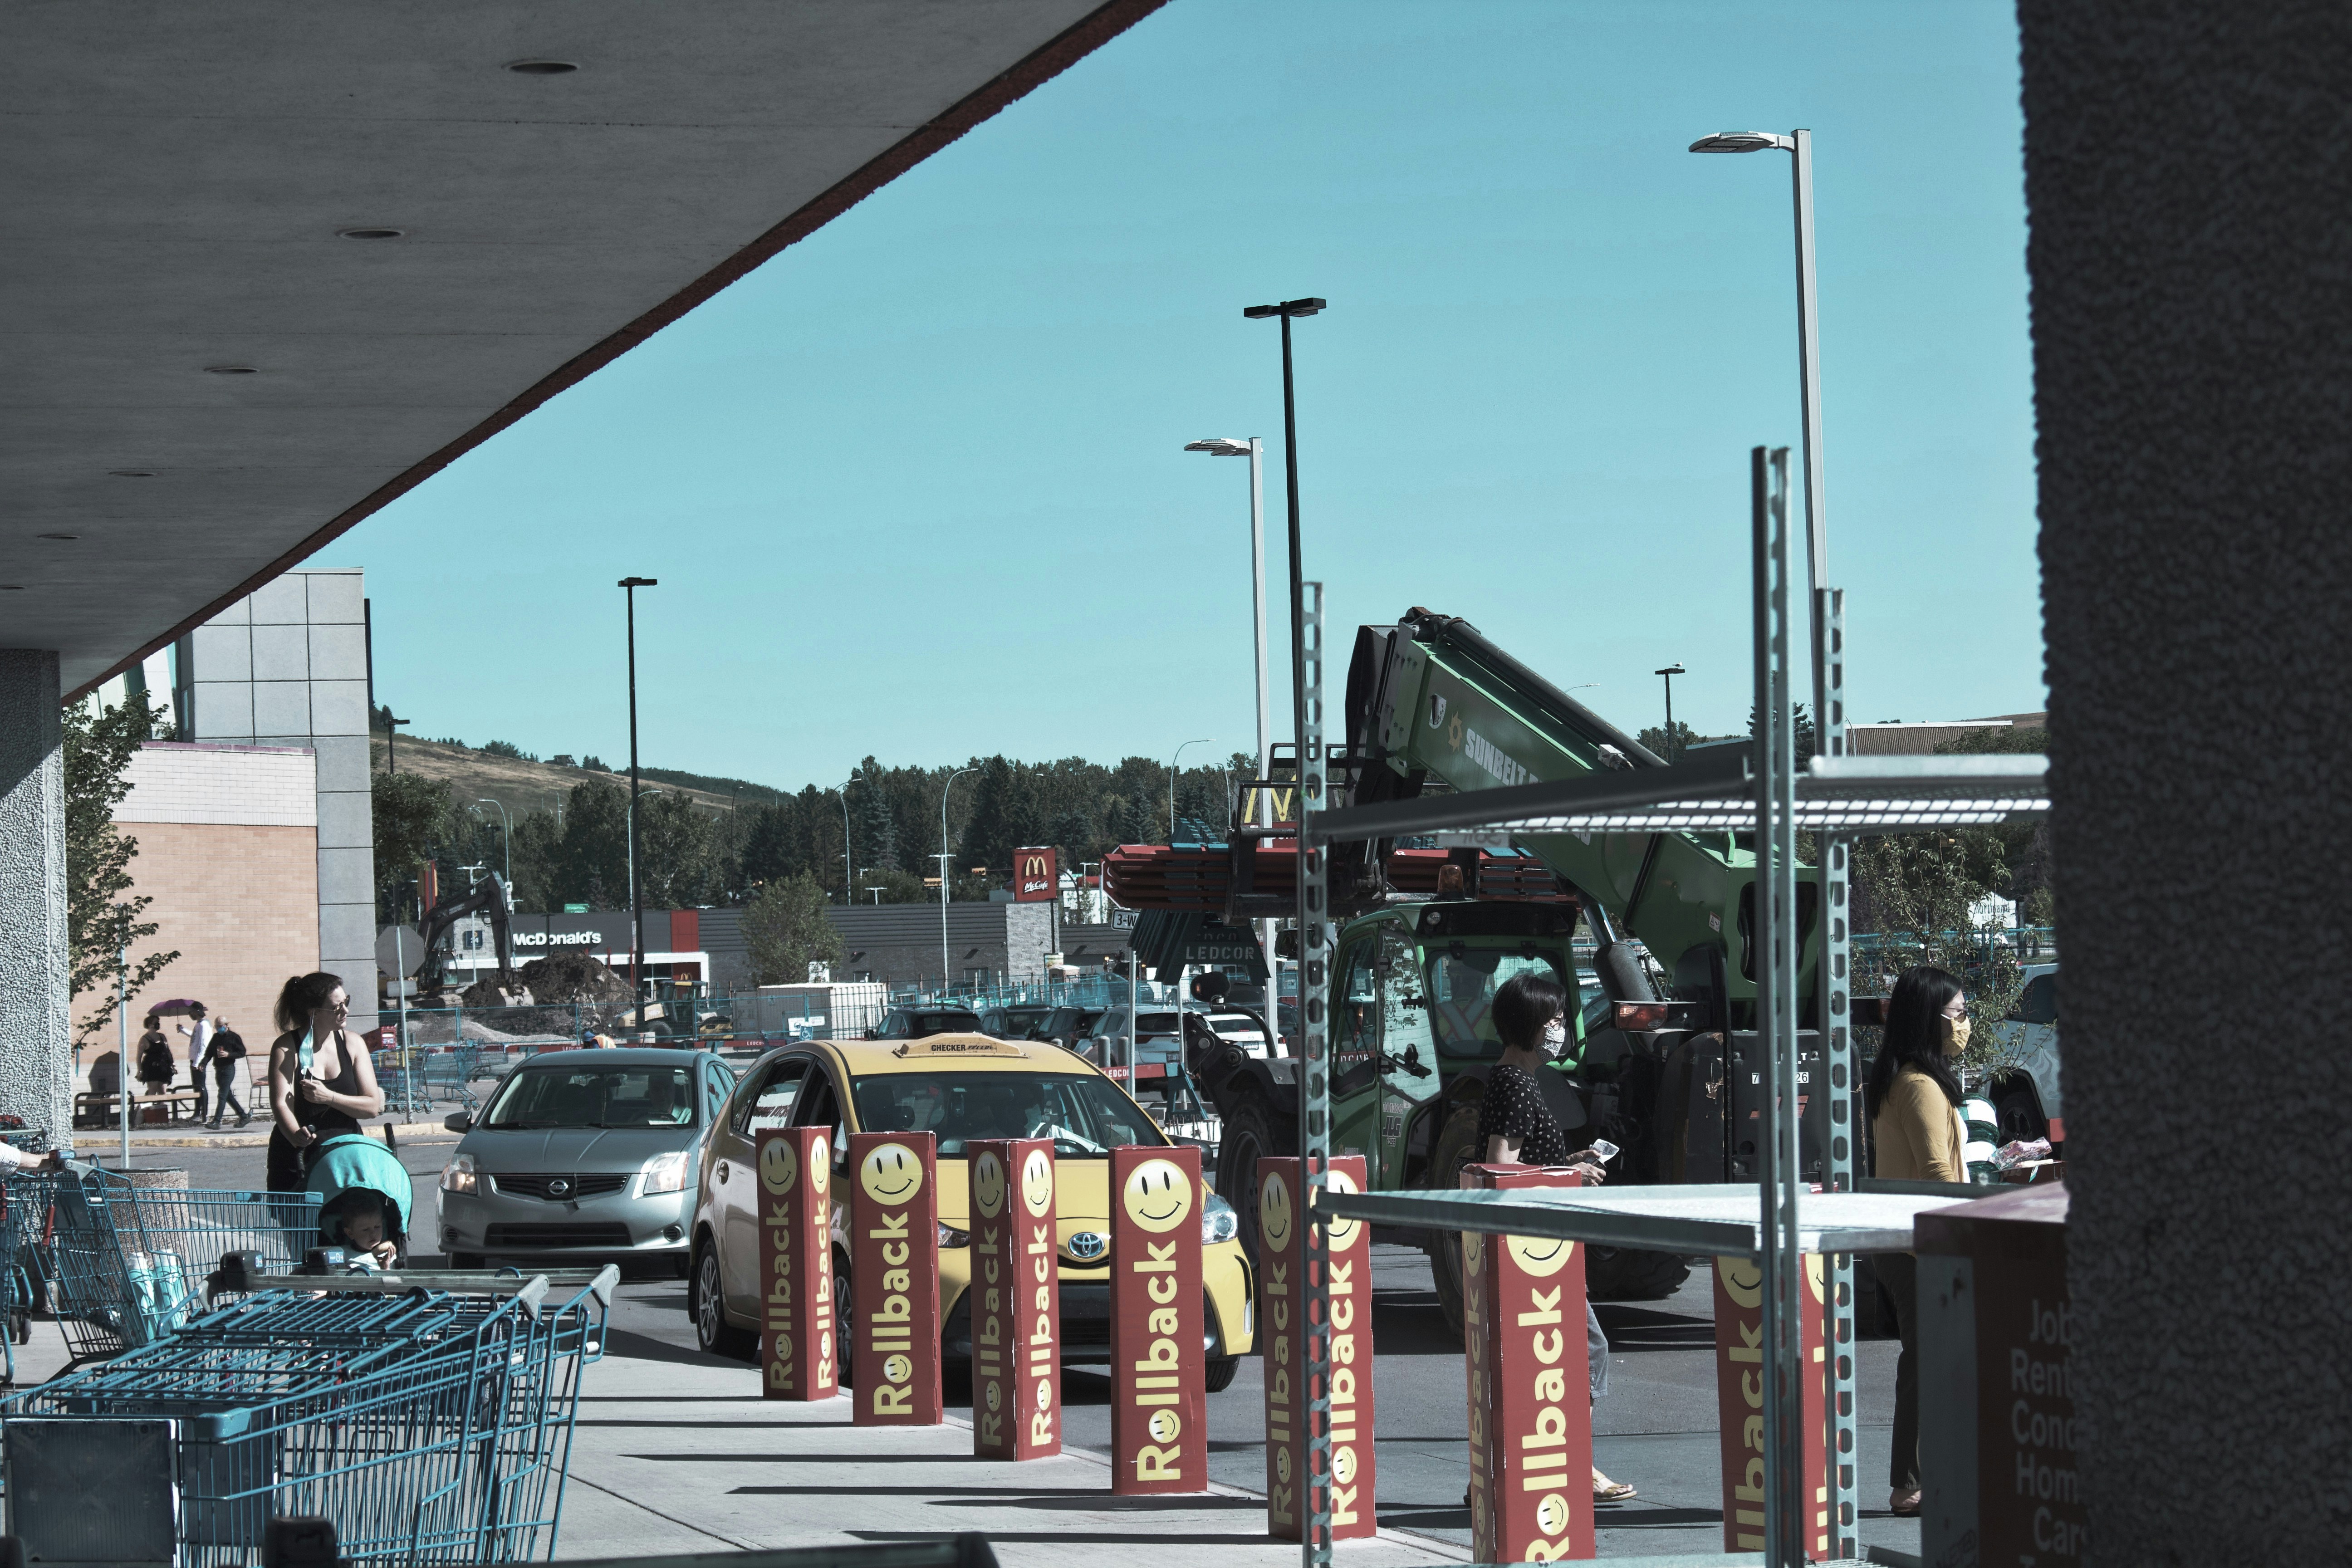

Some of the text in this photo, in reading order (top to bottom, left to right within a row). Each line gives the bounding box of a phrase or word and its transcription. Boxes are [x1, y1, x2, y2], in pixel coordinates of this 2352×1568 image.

[1465, 728, 1526, 786] SUNBELT
[513, 931, 602, 946] McDonald's
[1024, 881, 1048, 892] McCafé
[1185, 946, 1254, 960] LEDCOR
[766, 1201, 793, 1390] Rollback
[814, 1199, 832, 1389] Rollback
[870, 1212, 912, 1415] Rollback
[979, 1226, 1001, 1446] Rollback
[1028, 1224, 1051, 1446] Rollback
[1134, 1240, 1181, 1481] Rollback
[1267, 1262, 1293, 1524] Rollback
